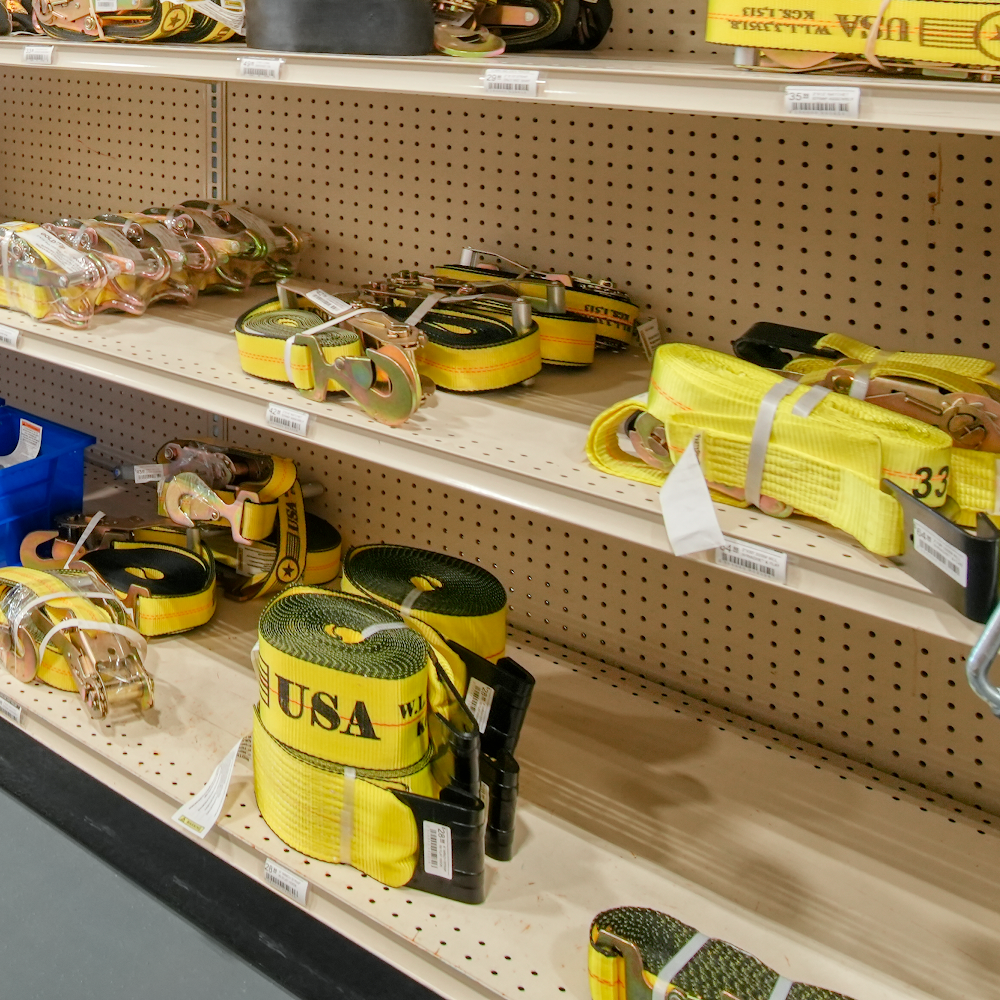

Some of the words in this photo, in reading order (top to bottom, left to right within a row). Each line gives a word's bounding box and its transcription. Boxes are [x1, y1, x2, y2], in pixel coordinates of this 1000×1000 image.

[834, 13, 912, 43] USA
[912, 465, 950, 499] 33
[274, 672, 381, 741] USA
